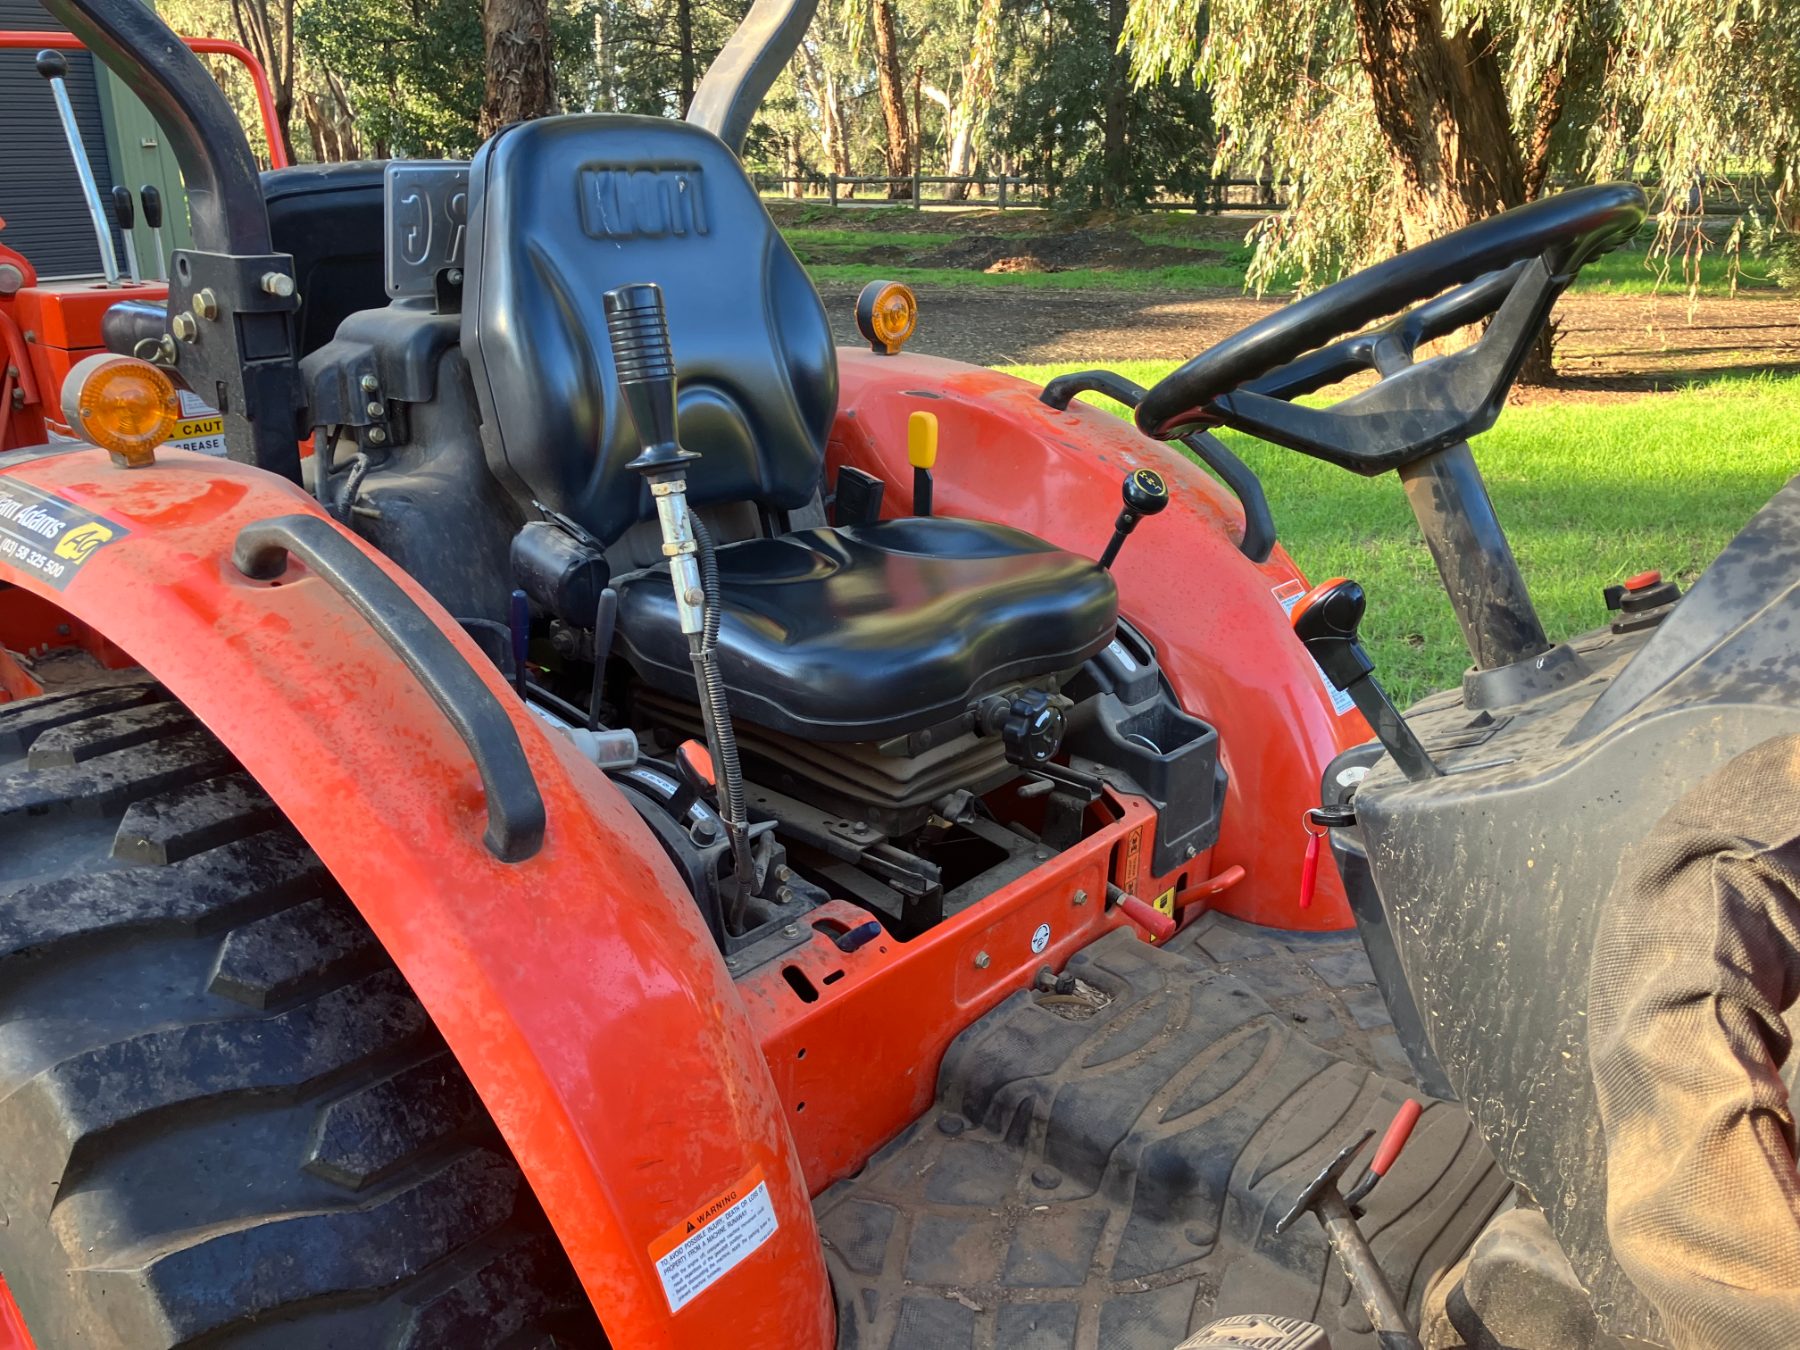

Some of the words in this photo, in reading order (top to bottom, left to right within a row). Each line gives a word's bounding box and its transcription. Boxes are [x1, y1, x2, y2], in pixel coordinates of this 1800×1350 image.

[183, 421, 222, 435] CAUT
[12, 504, 66, 538] Adams
[15, 545, 30, 560] 58
[26, 551, 48, 568] 325
[43, 559, 65, 578] 500
[696, 1189, 737, 1225] WARNING
[668, 1246, 683, 1261] AVOID
[684, 1229, 706, 1250] POSSIBLE
[725, 1204, 739, 1219] DEATH
[747, 1189, 758, 1202] LOSS
[662, 1253, 686, 1276] PROPERTY
[687, 1242, 701, 1257] FROM
[706, 1224, 726, 1244] MACHINE
